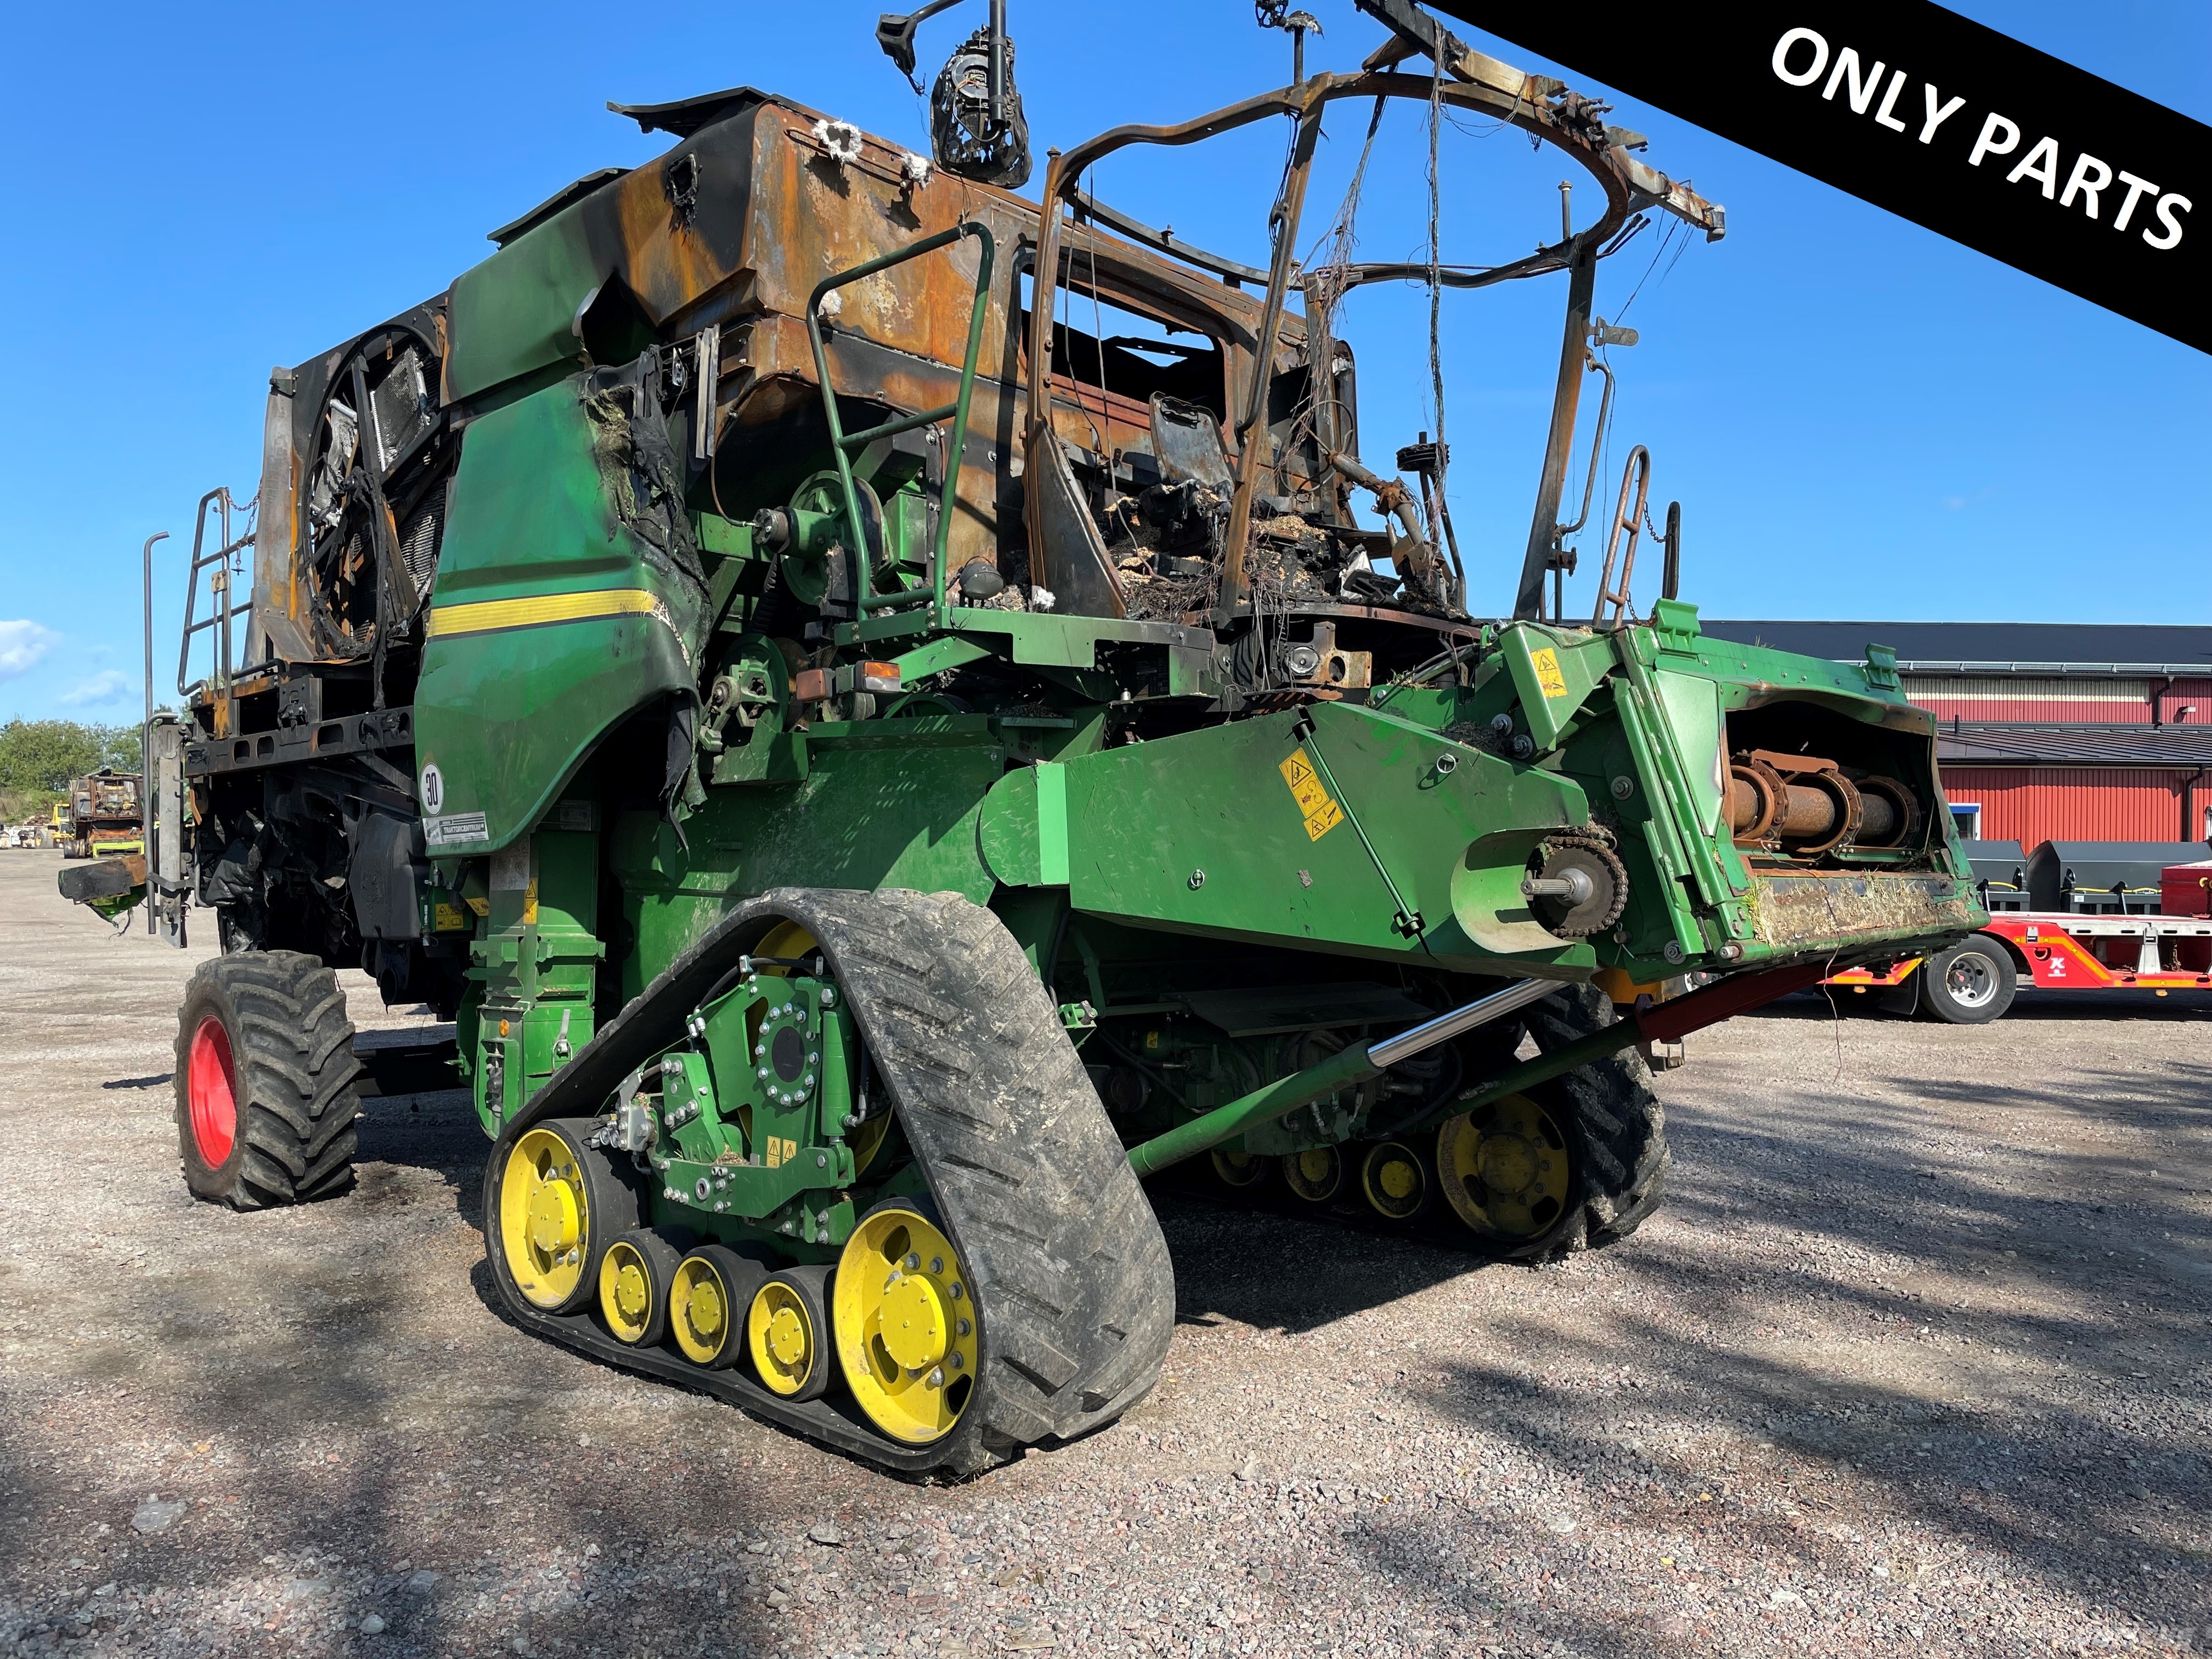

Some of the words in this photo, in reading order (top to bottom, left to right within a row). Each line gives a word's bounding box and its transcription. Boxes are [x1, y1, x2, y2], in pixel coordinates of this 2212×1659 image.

[426, 772, 438, 806] 30
[443, 823, 481, 834] TRAKTORCENTRUM
[2050, 957, 2066, 969] K
